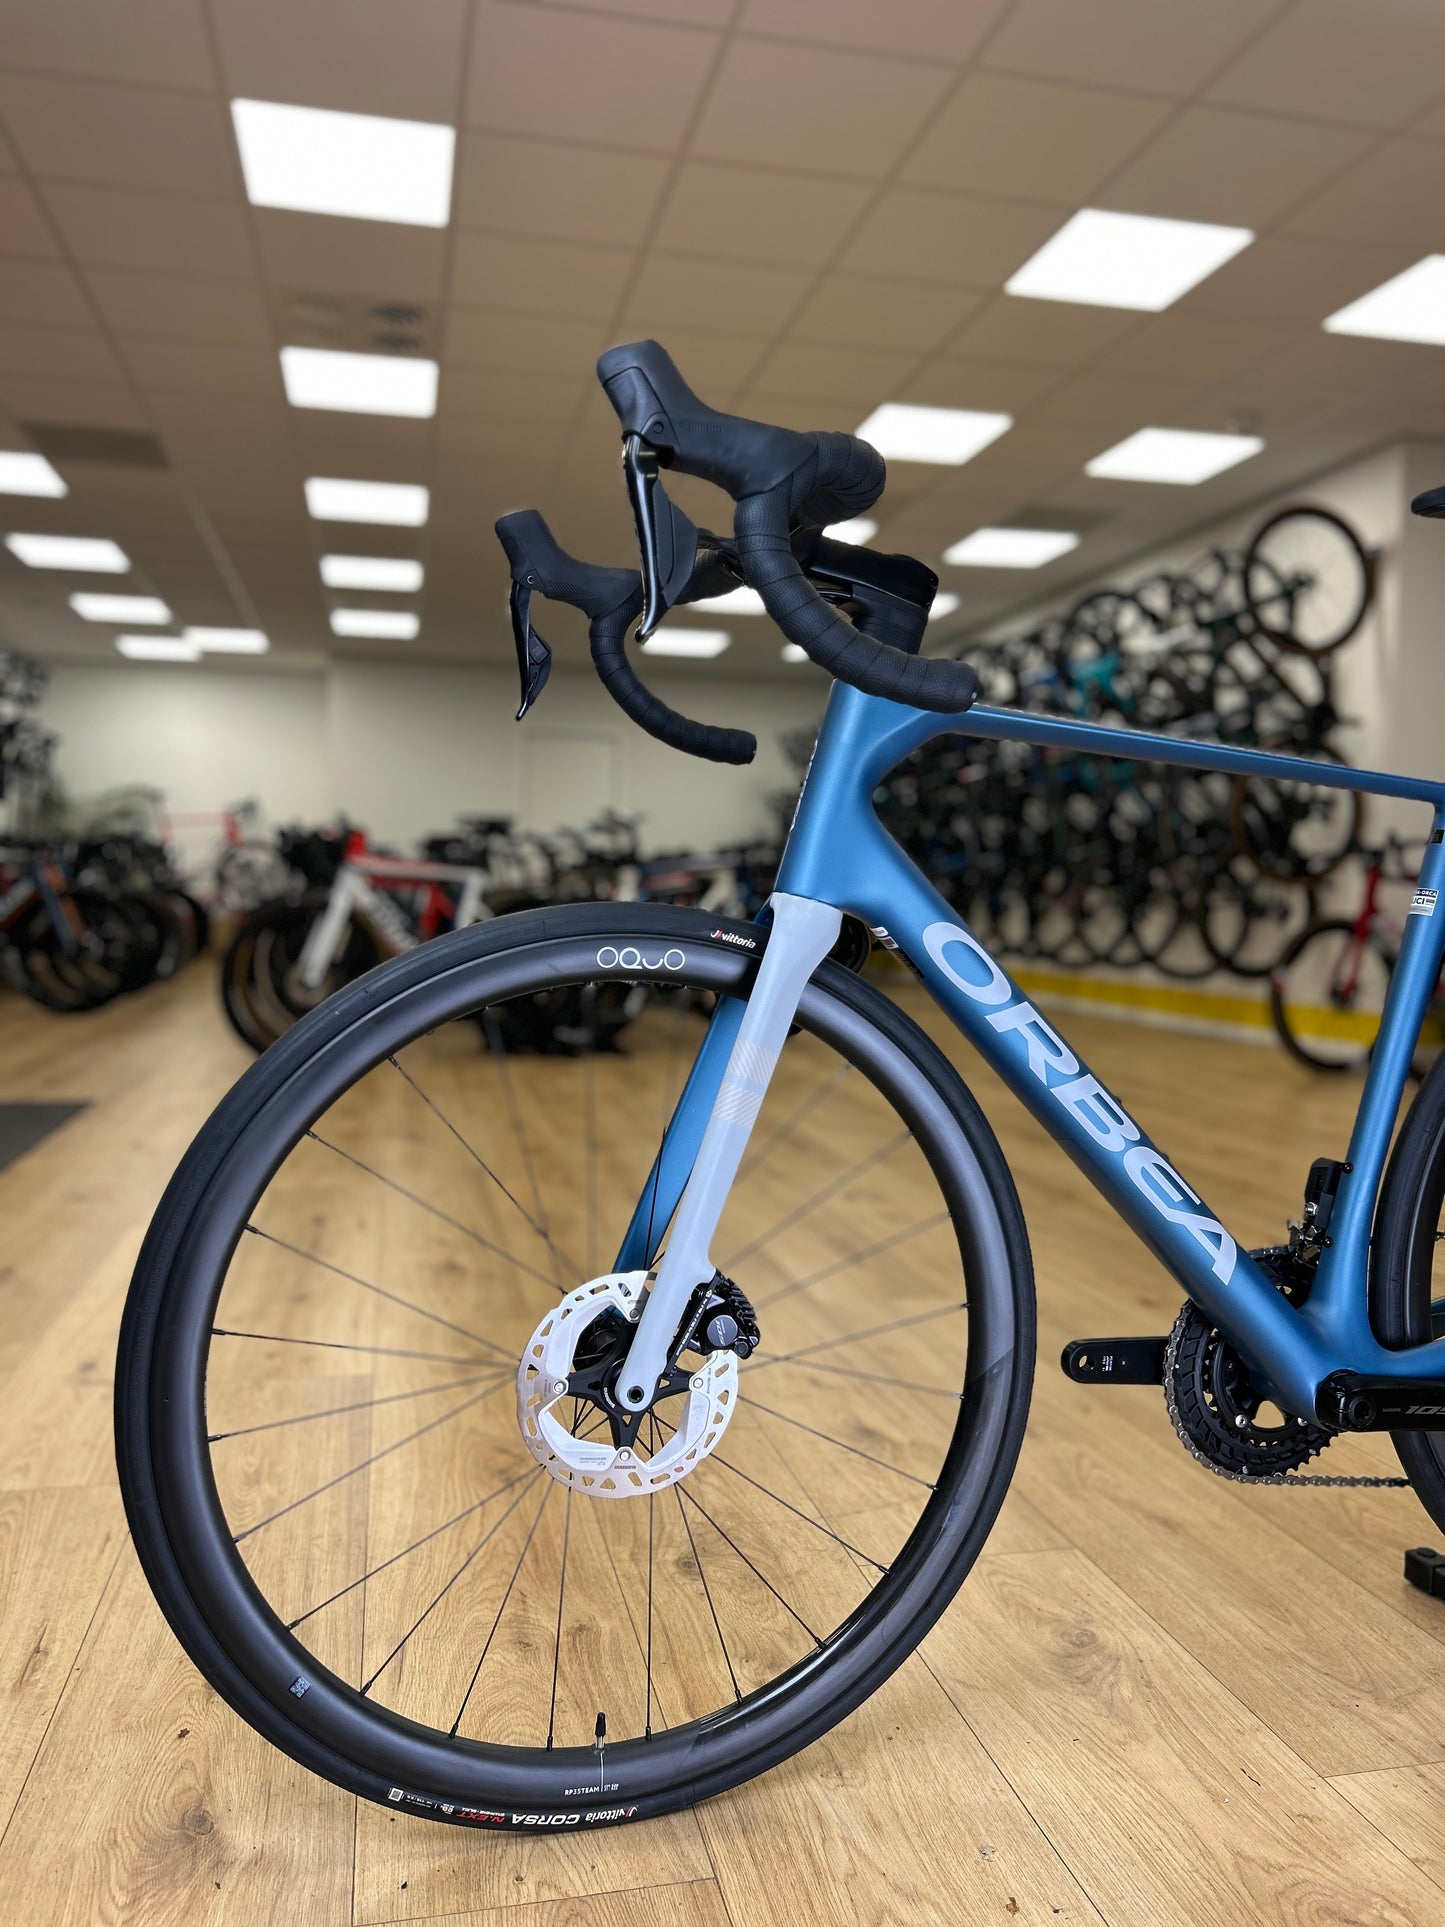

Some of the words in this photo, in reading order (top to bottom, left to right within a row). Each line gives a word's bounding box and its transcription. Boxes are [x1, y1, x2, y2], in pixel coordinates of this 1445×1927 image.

[721, 932, 756, 949] vittoria
[923, 922, 1237, 1286] ORBEA
[512, 1814, 580, 1825] CORSA
[585, 1808, 626, 1823] vittoria
